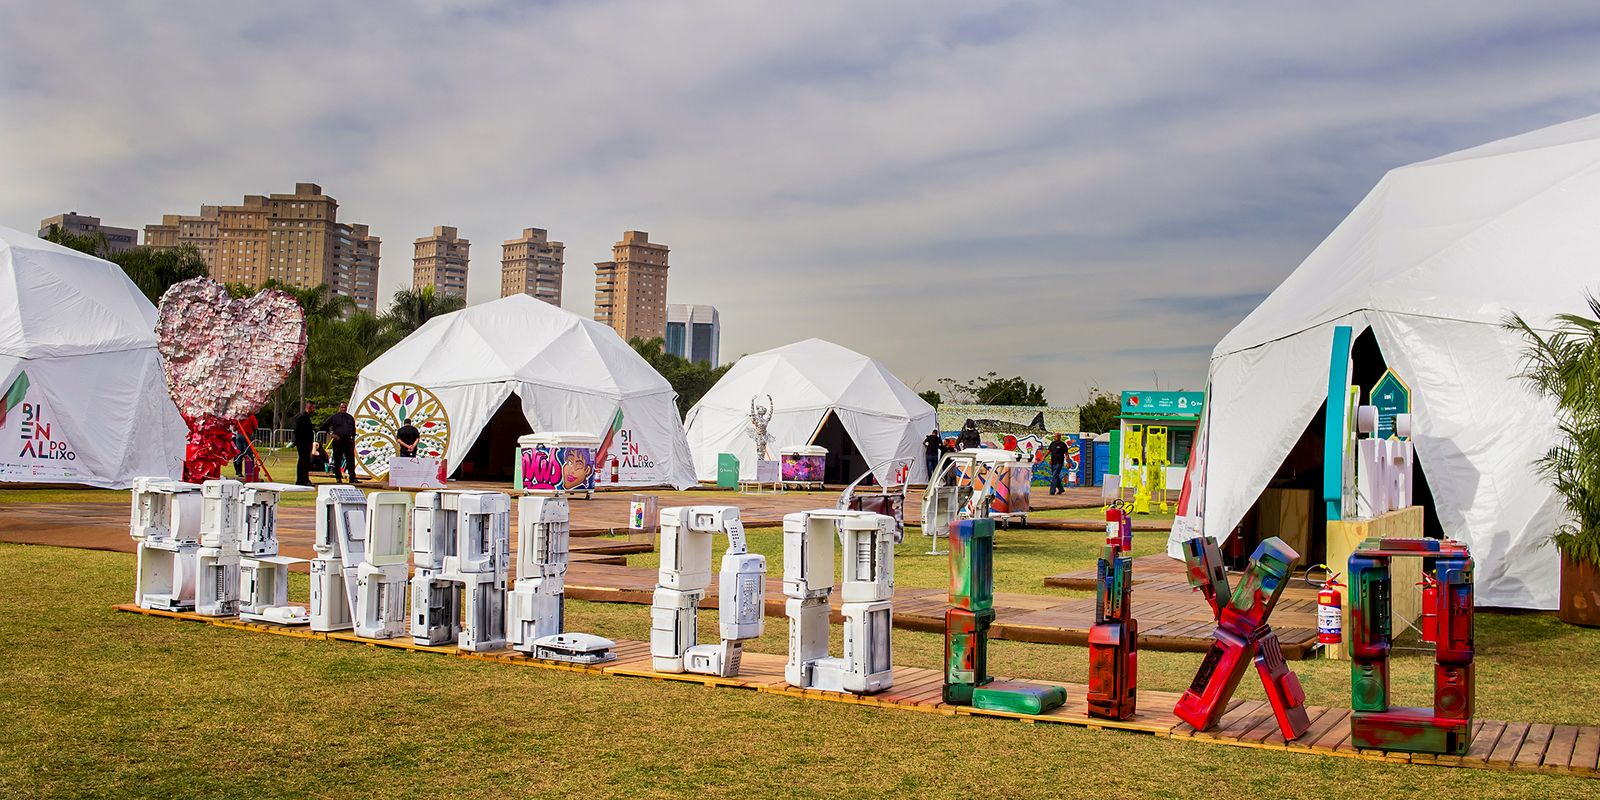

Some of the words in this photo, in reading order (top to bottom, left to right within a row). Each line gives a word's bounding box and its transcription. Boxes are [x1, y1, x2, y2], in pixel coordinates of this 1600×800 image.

[22, 402, 41, 422] BI
[20, 421, 51, 441] EN
[19, 440, 48, 459] AL
[49, 441, 67, 451] DO
[49, 450, 76, 461] LIXO
[637, 454, 649, 462] DO
[650, 504, 895, 695] DO
[942, 517, 1475, 756] LIXO
